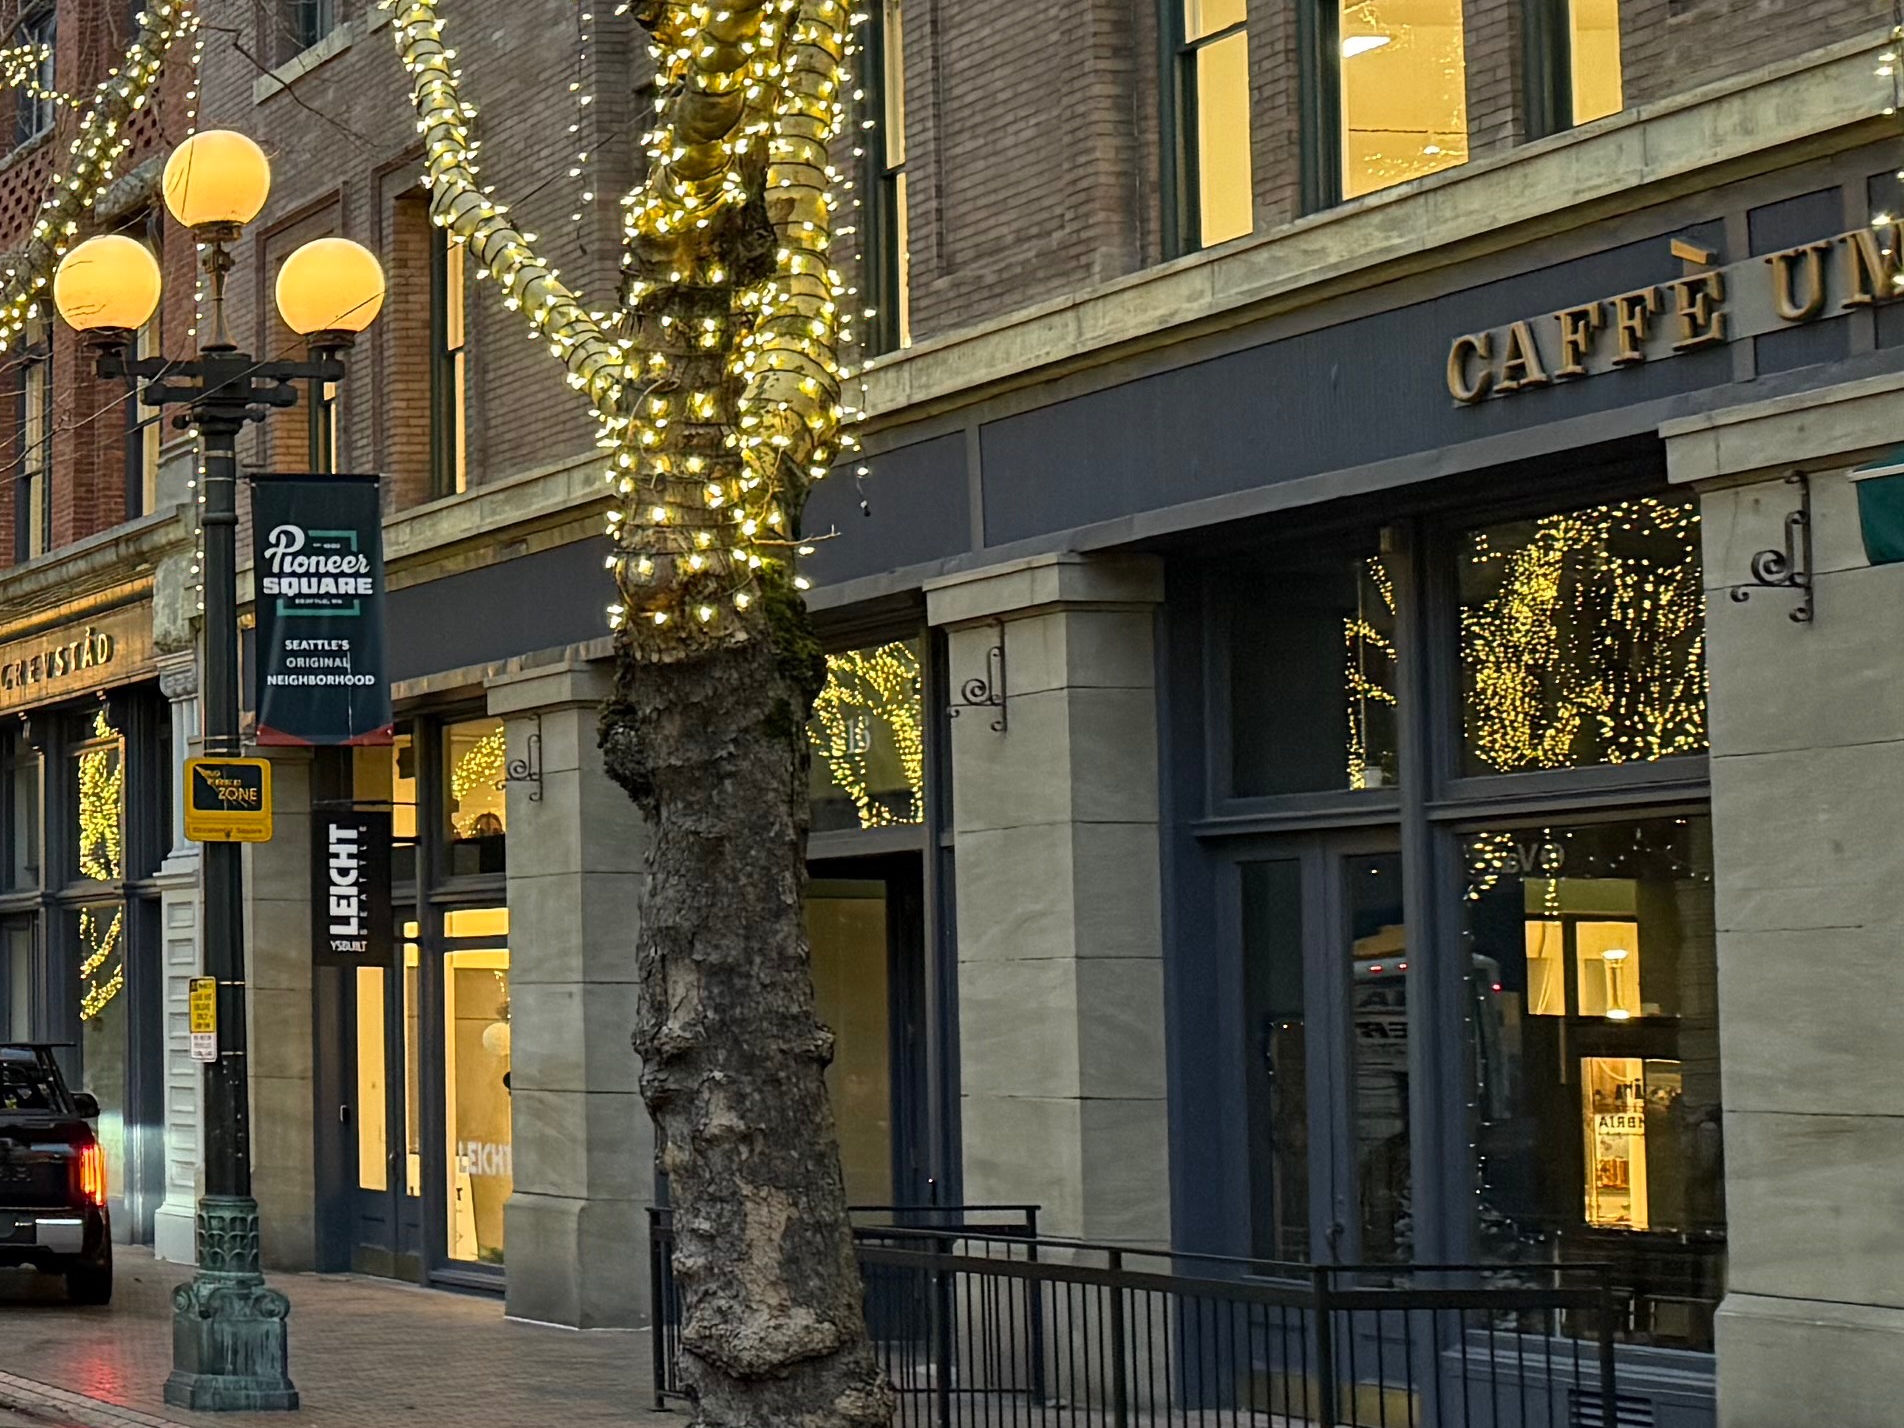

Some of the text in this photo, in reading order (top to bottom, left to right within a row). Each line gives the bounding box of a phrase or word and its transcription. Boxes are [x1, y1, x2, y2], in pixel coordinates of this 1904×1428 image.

[1446, 237, 1726, 403] CAFFÈ
[264, 524, 371, 574] Pioneer
[263, 577, 373, 597] SQUARE
[285, 640, 350, 651] SEATTLE'S
[286, 657, 349, 668] ORIGINAL
[267, 674, 375, 685] NEIGHBORHOOD
[218, 787, 257, 800] ZONE
[329, 824, 358, 935] LEICHT
